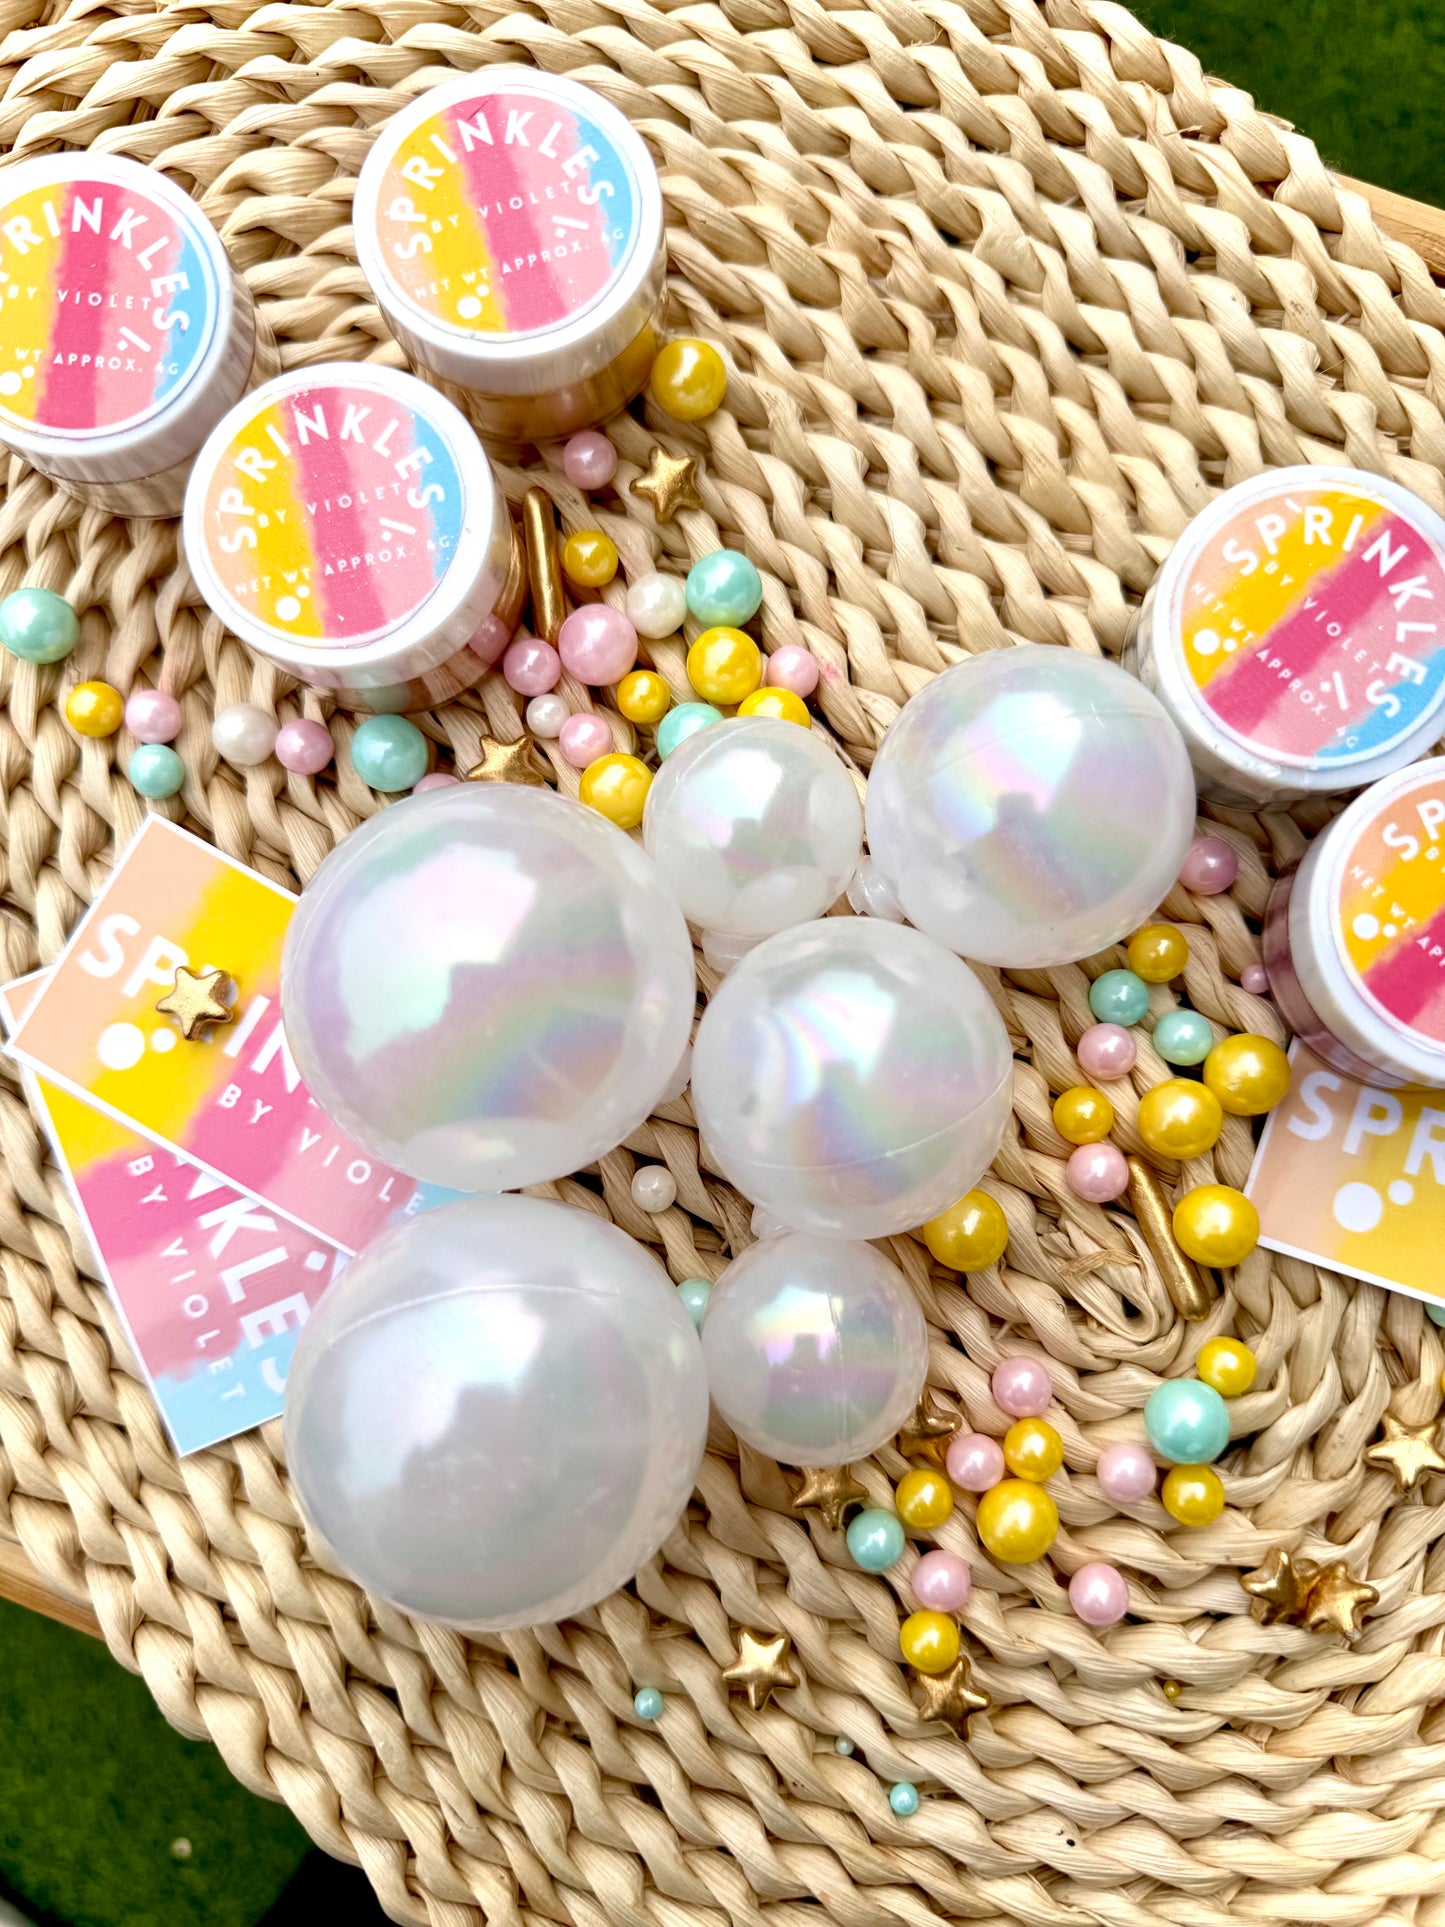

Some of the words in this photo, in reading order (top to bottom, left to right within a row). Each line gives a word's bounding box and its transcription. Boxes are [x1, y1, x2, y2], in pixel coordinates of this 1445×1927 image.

[388, 110, 615, 260] SPRINKLES
[430, 214, 460, 235] BY
[477, 181, 572, 219] VIOLET
[0, 196, 191, 331] RINKLES
[415, 279, 450, 300] NET
[462, 268, 489, 285] WT
[502, 240, 590, 275] APPROX.
[8, 285, 38, 301] BY
[57, 289, 152, 311] VIOLET
[15, 348, 43, 362] WT
[53, 353, 144, 373] APPROX.
[218, 404, 446, 553] SPRINKLES
[257, 509, 288, 529] BY
[307, 483, 402, 516] VIOLET
[235, 576, 272, 596] NET
[283, 568, 312, 584] WT
[1190, 582, 1224, 613] NET
[1229, 618, 1256, 644] WT
[1222, 506, 1437, 719] SPRINKLES
[1264, 560, 1294, 588] BY
[1302, 597, 1381, 675] VIOLET
[1424, 846, 1445, 875] B
[1349, 865, 1386, 899] NET
[1388, 902, 1417, 930] WT
[218, 1084, 273, 1125] BY
[300, 1127, 426, 1216] VIOLE
[127, 1154, 168, 1205] BY
[161, 1236, 247, 1401] VIOLET
[177, 1155, 311, 1393] KLE
